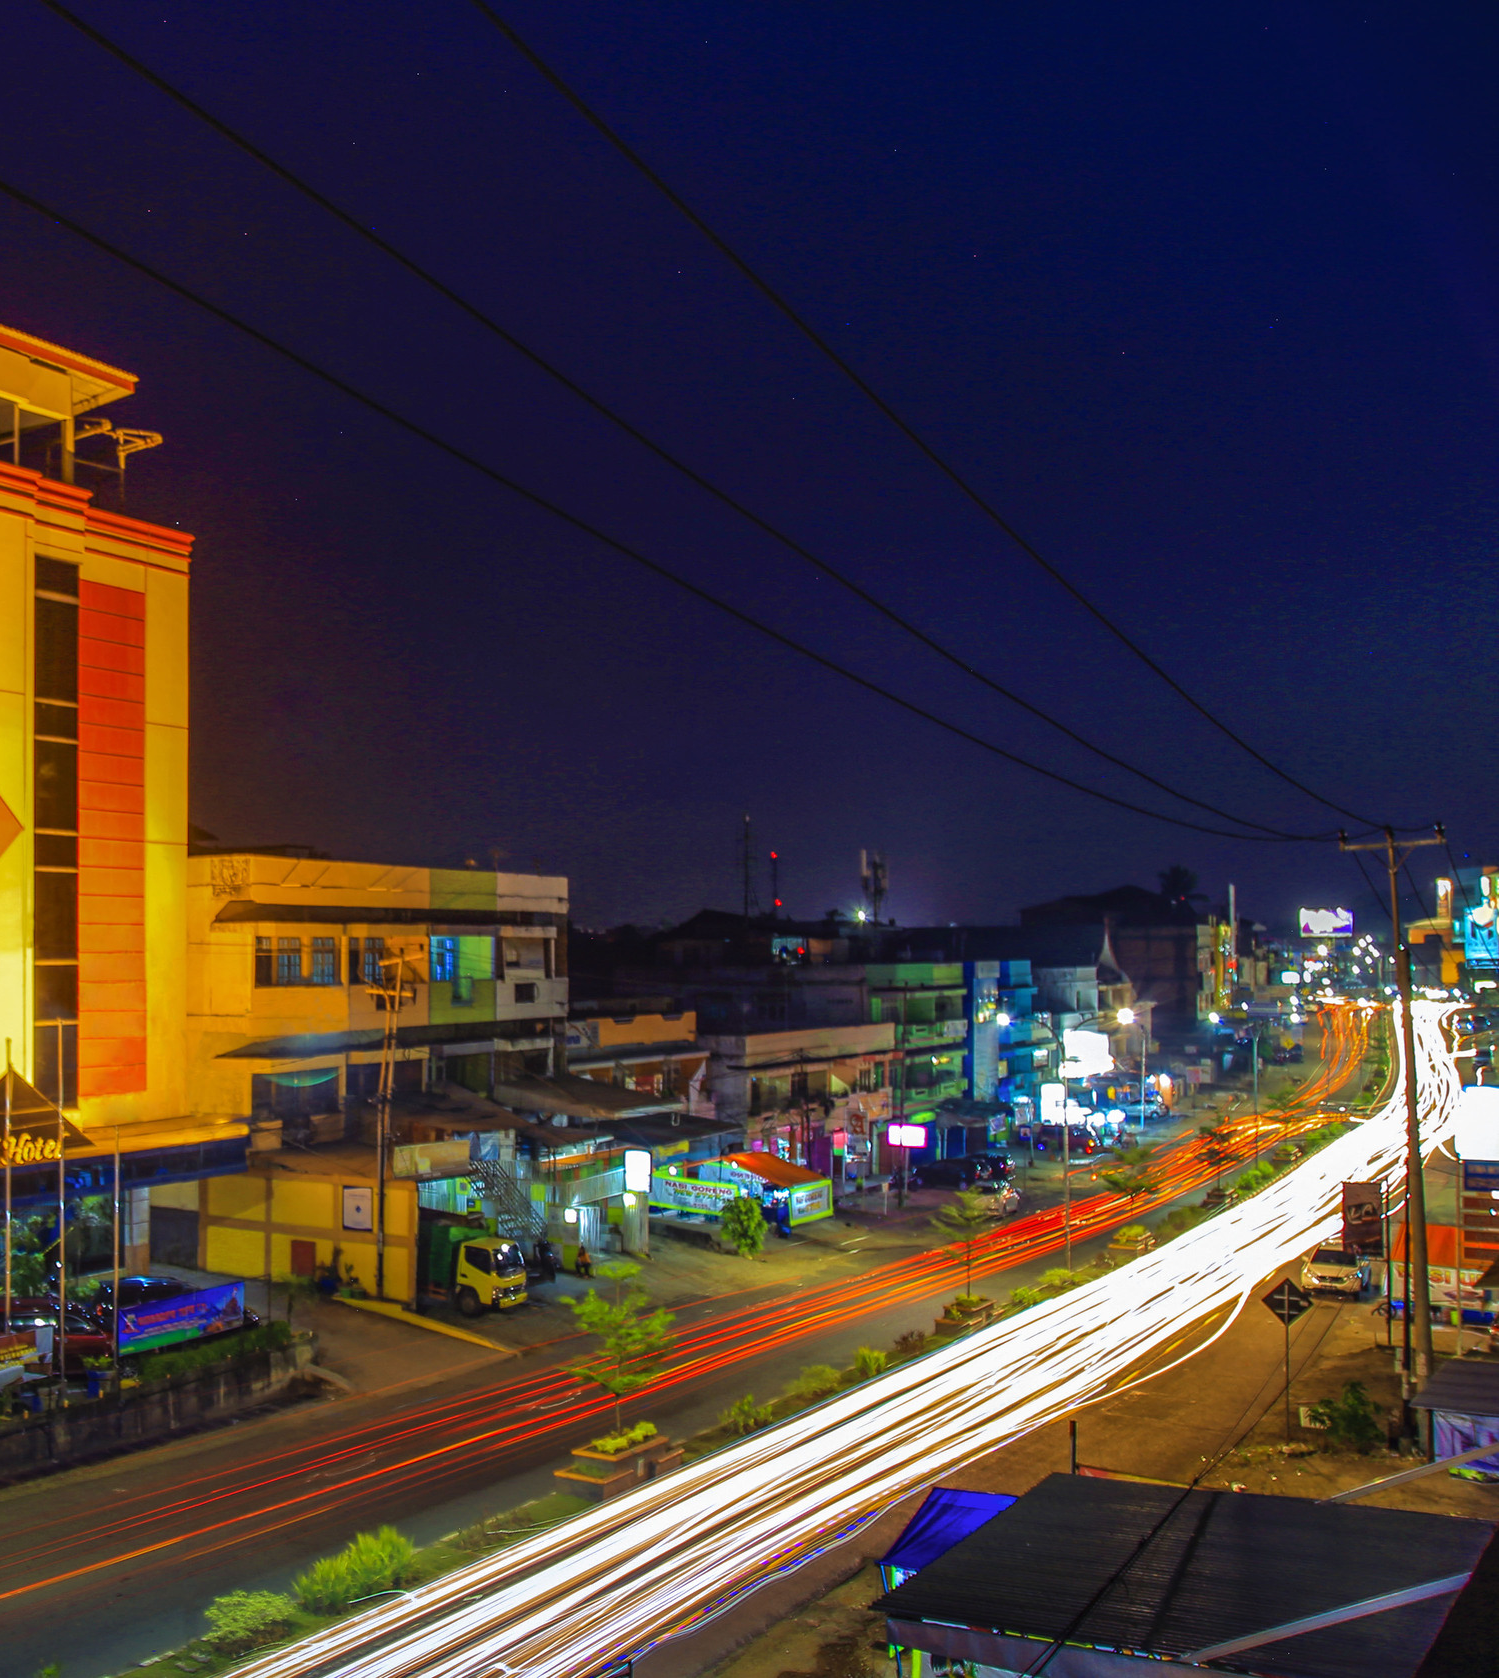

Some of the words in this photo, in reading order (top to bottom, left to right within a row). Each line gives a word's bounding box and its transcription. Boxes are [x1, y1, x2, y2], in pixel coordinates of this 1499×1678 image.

[1, 1131, 70, 1166] Hotel
[664, 1180, 688, 1191] NASI
[691, 1184, 733, 1197] GORENG
